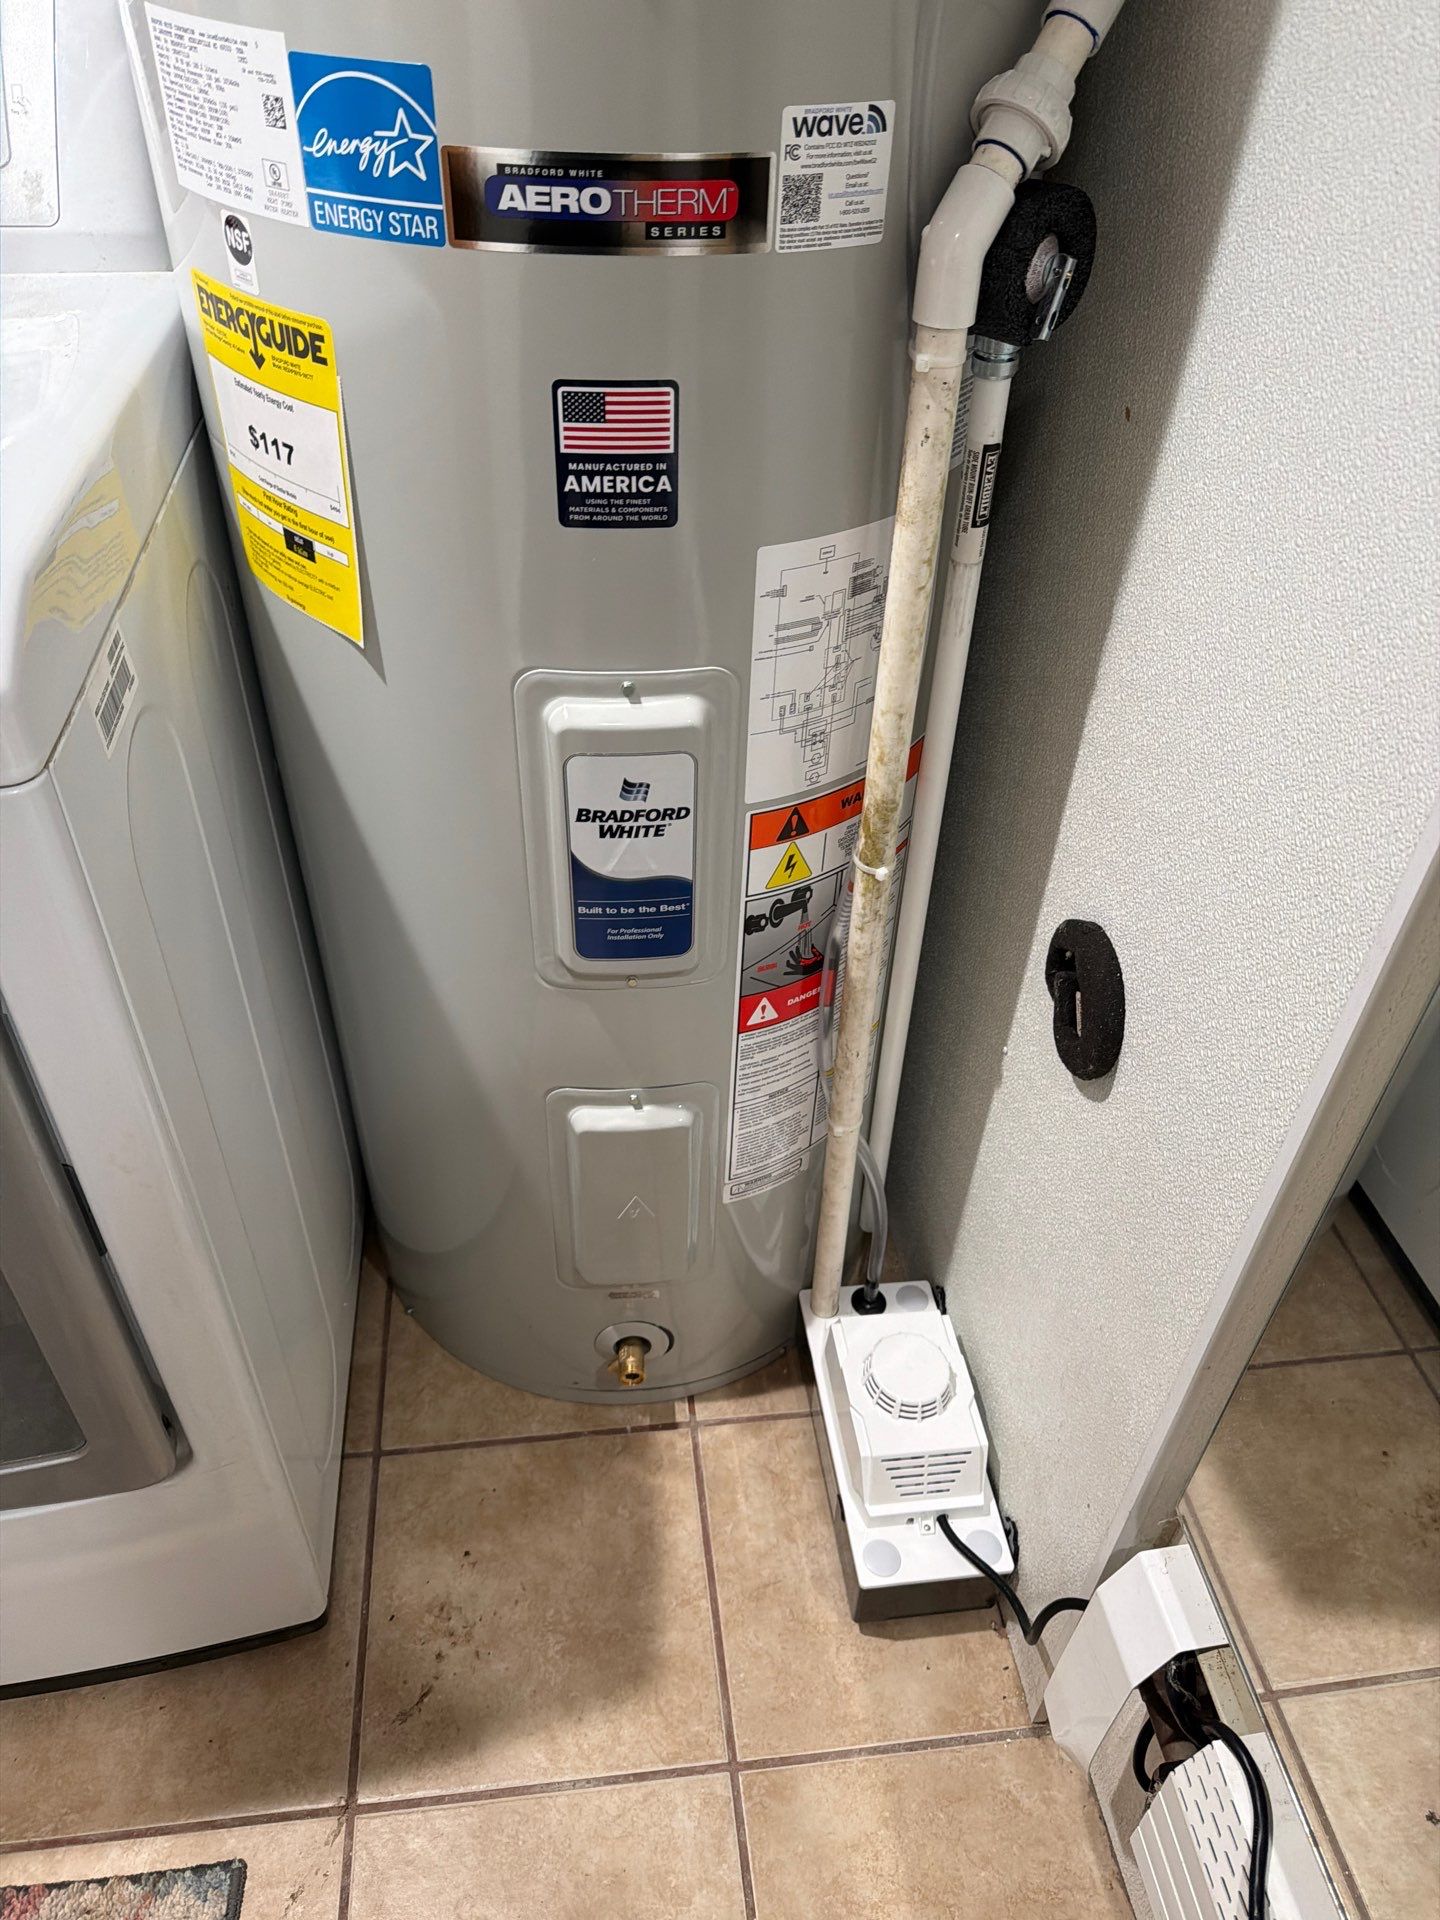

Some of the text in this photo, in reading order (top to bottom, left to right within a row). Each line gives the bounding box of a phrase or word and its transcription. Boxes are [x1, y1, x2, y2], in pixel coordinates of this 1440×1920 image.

[792, 113, 864, 138] wave
[504, 166, 604, 178] BRADFORD WHITE
[315, 201, 384, 229] ENERGY
[388, 213, 439, 240] STAR
[651, 226, 722, 237] SERIES
[224, 223, 252, 255] NSF
[248, 424, 294, 466] $117
[568, 462, 667, 471] MANUFACTURED IN
[563, 474, 672, 493] AMERICA
[569, 506, 609, 514] MATERIALS
[618, 506, 668, 514] COMPONENTS
[592, 514, 623, 522] AROUND
[575, 806, 691, 823] BRADFORD
[578, 905, 603, 915] Built
[606, 905, 617, 914] to
[621, 904, 635, 914] be
[639, 904, 656, 914] the
[619, 926, 662, 934] Professional
[607, 932, 665, 941] Installation Only
